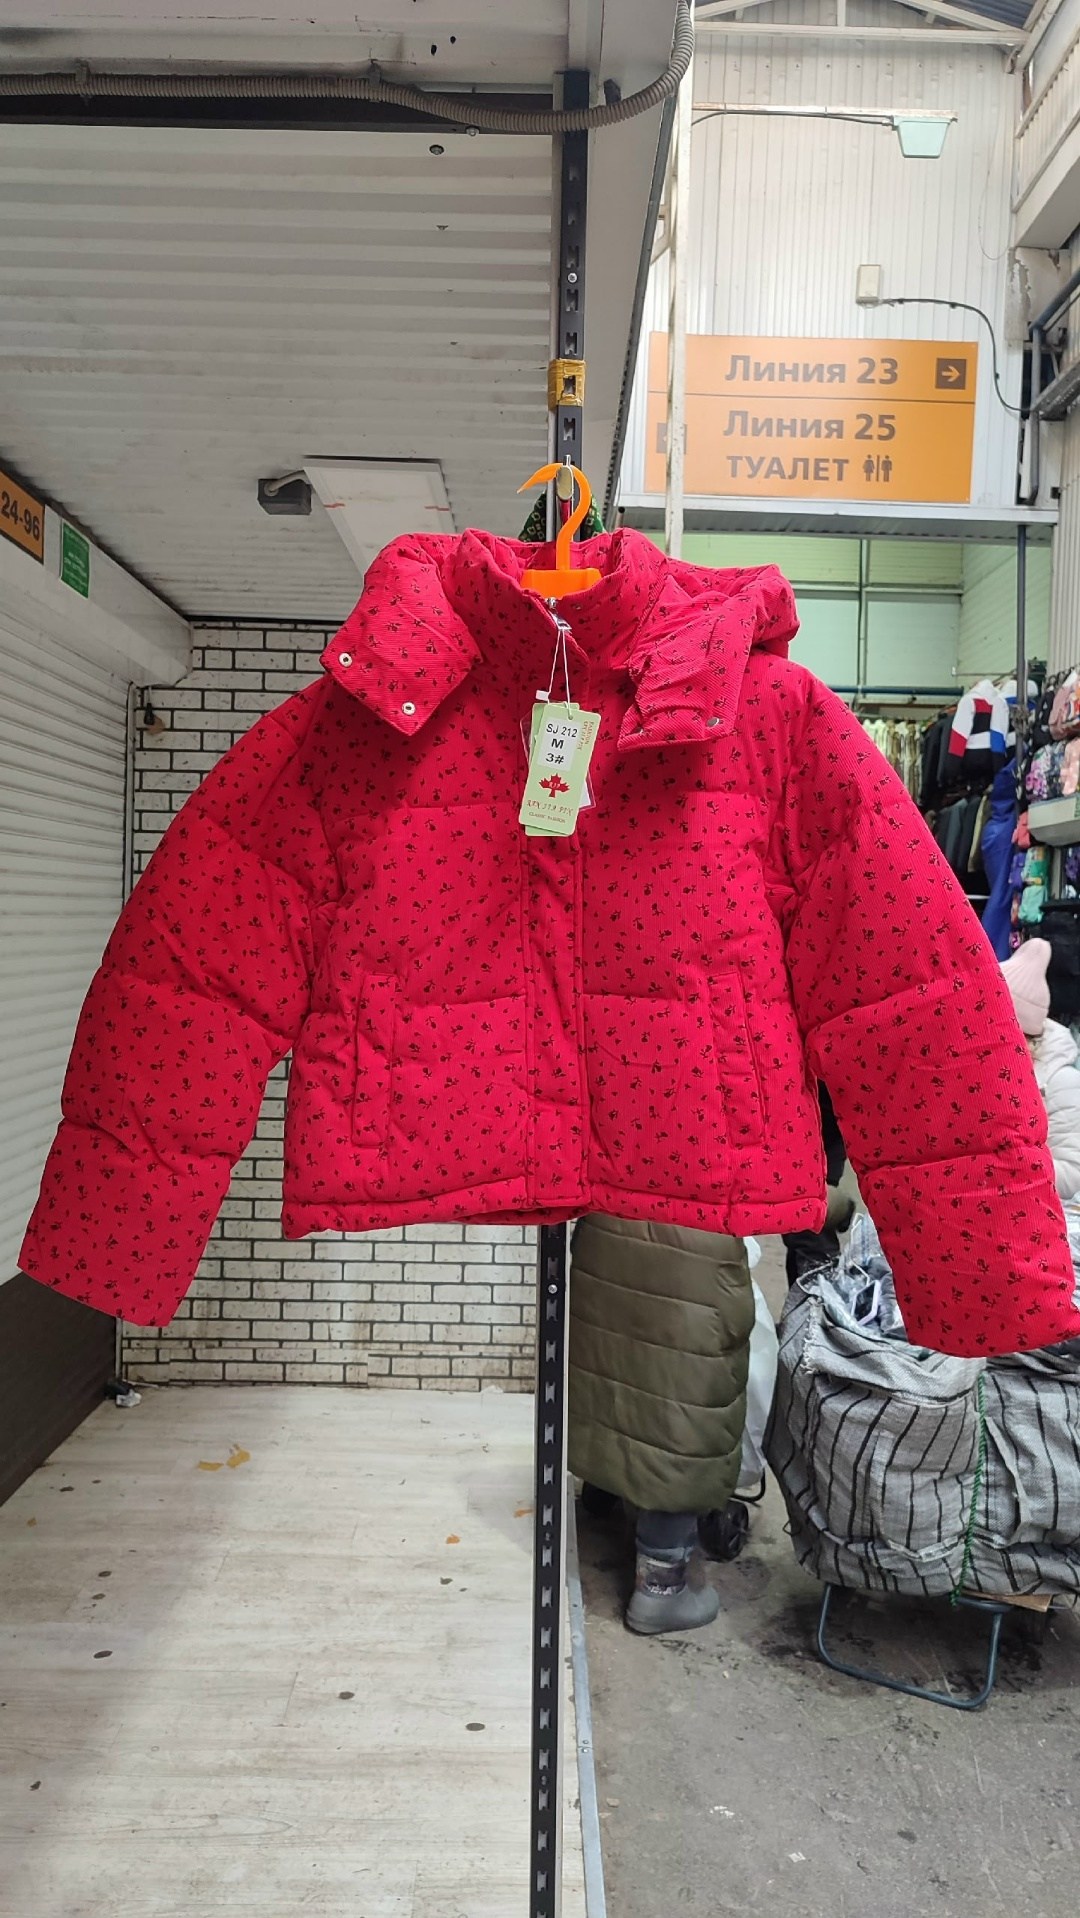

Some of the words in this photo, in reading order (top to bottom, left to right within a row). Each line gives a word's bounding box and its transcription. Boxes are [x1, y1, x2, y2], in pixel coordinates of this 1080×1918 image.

[725, 355, 846, 383] Линия
[857, 358, 899, 385] 23
[723, 410, 844, 439] Линия
[854, 414, 896, 441] 25
[726, 456, 849, 481] ТУАЛЕТ
[1, 491, 41, 541] 24-96
[546, 723, 559, 734] SJ
[561, 726, 578, 738] 212
[551, 738, 564, 749] M
[545, 753, 565, 764] 3#
